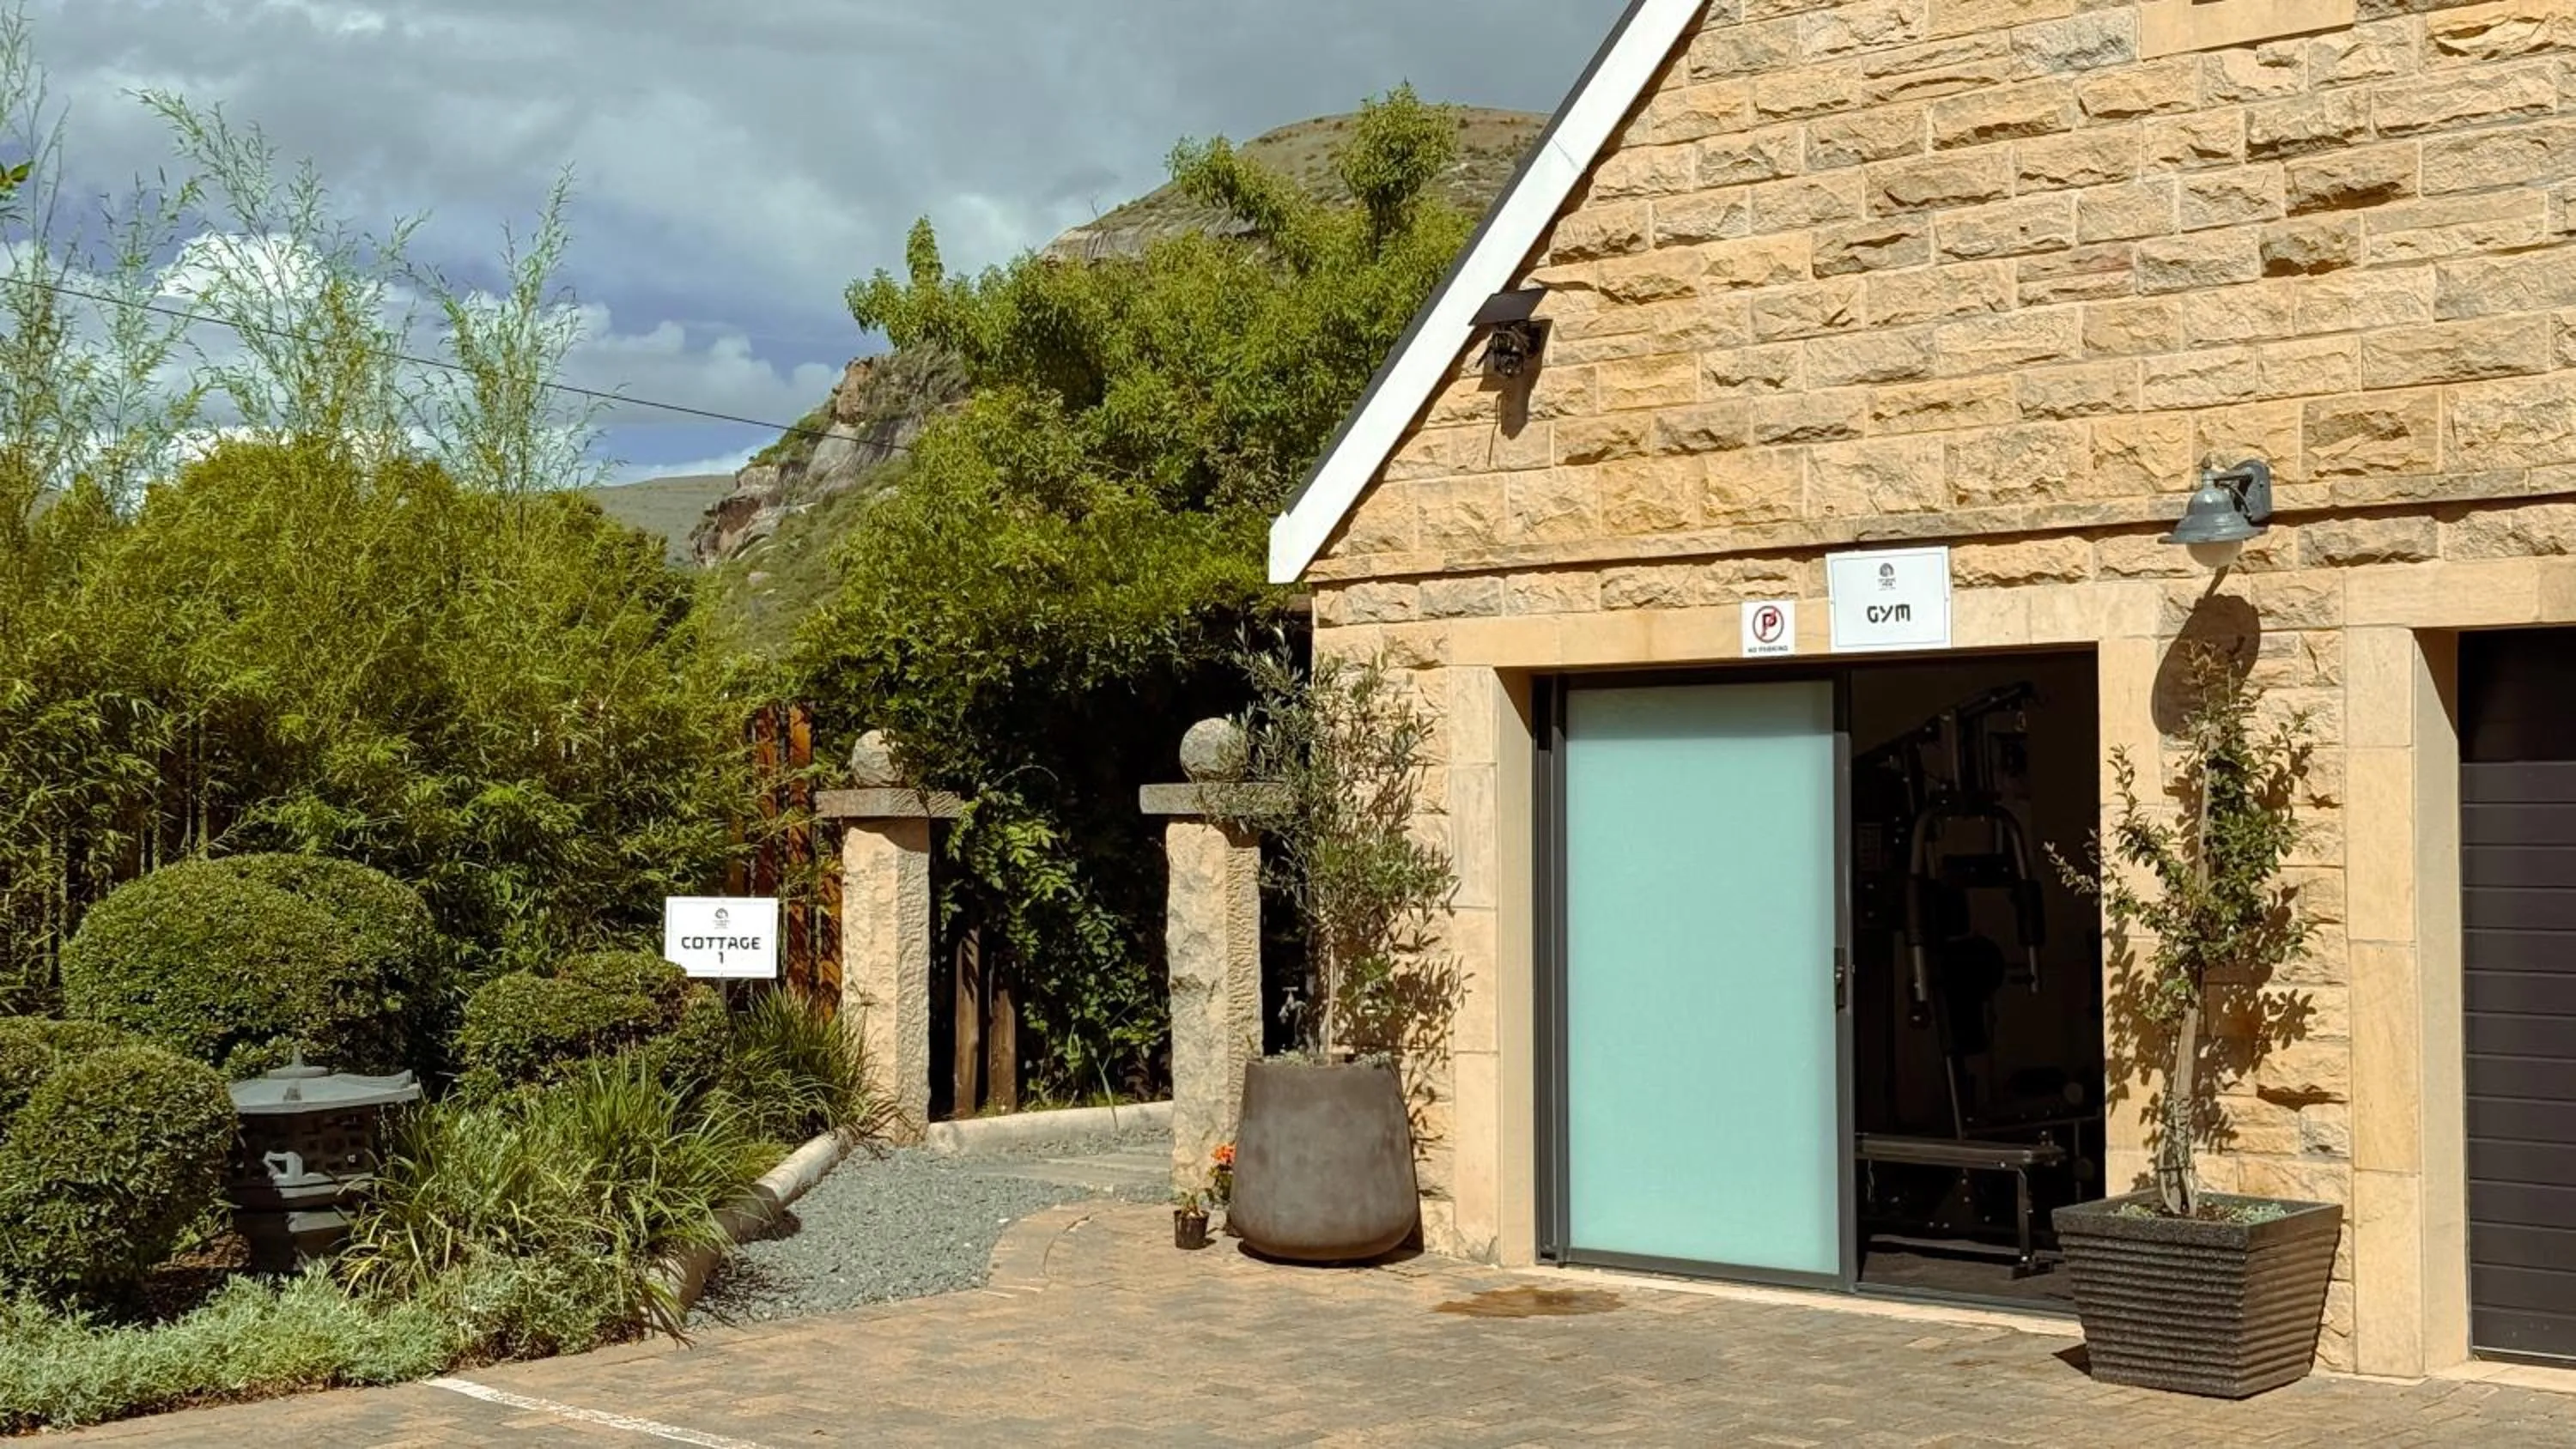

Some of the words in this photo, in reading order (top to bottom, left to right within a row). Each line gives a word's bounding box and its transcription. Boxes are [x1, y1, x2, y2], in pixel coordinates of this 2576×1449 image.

[1867, 603, 1911, 623] GYM
[681, 937, 761, 950] COTTAGE
[718, 950, 725, 964] 1
